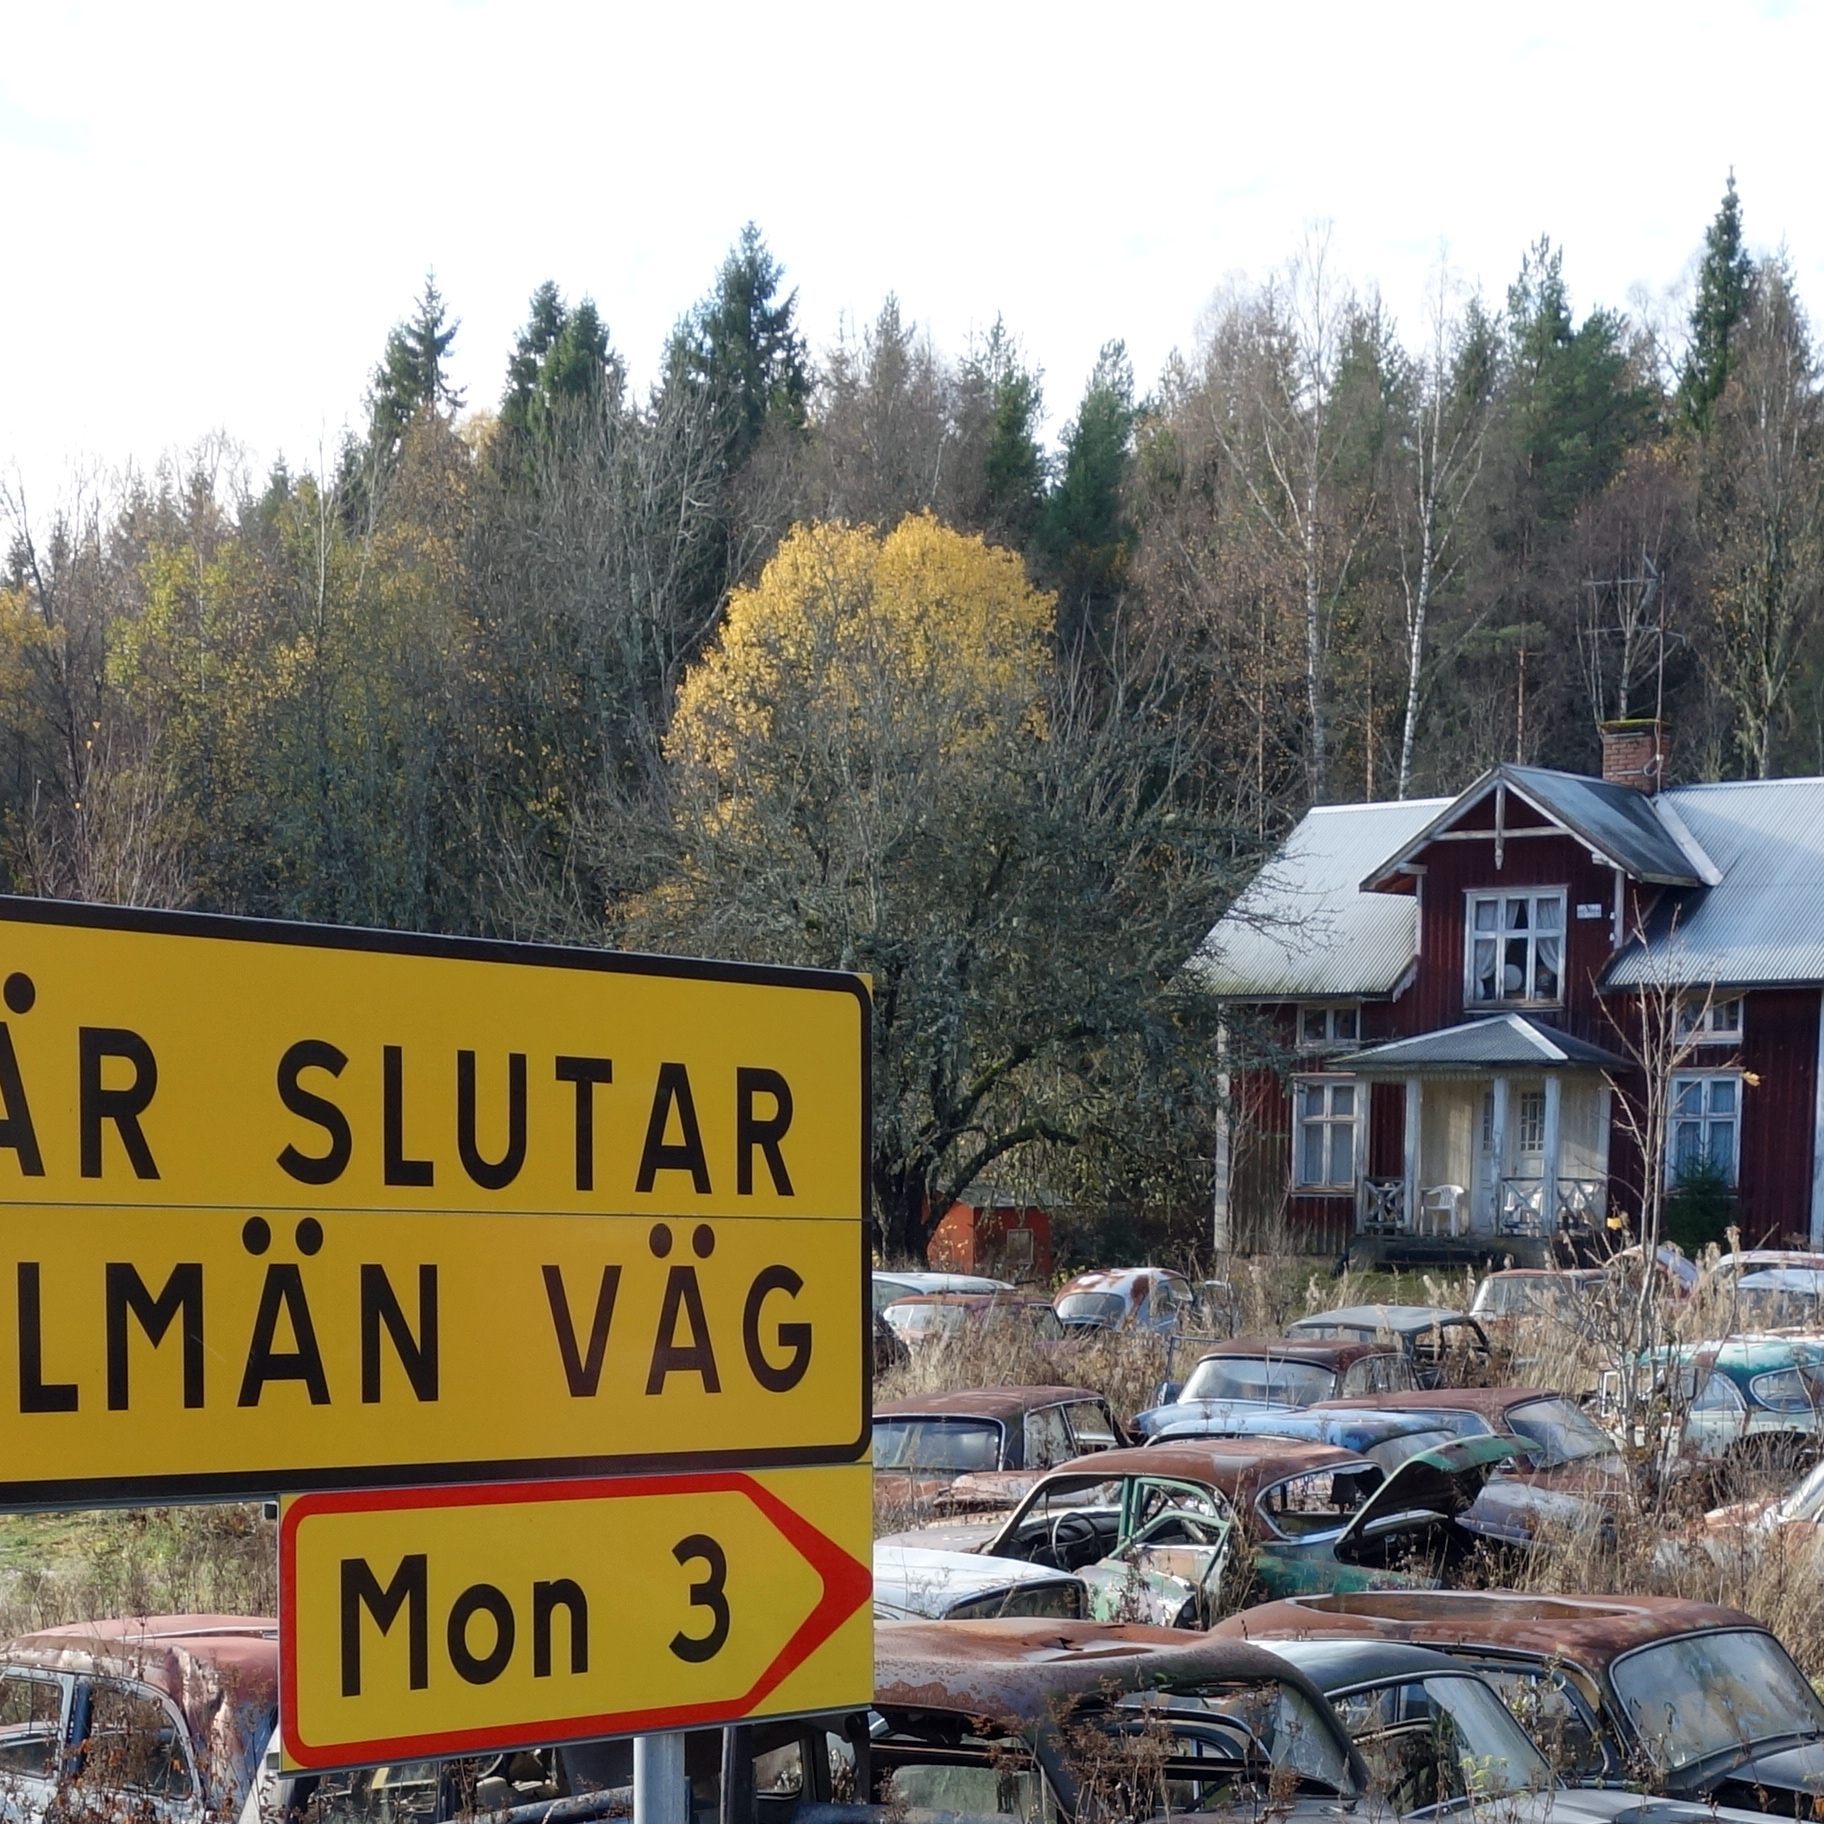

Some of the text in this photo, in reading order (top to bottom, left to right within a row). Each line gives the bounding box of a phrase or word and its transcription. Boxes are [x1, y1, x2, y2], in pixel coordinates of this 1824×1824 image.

[277, 1040, 794, 1196] SLUTAR
[542, 1223, 812, 1397] VÄG
[341, 1534, 730, 1697] Mon 3
